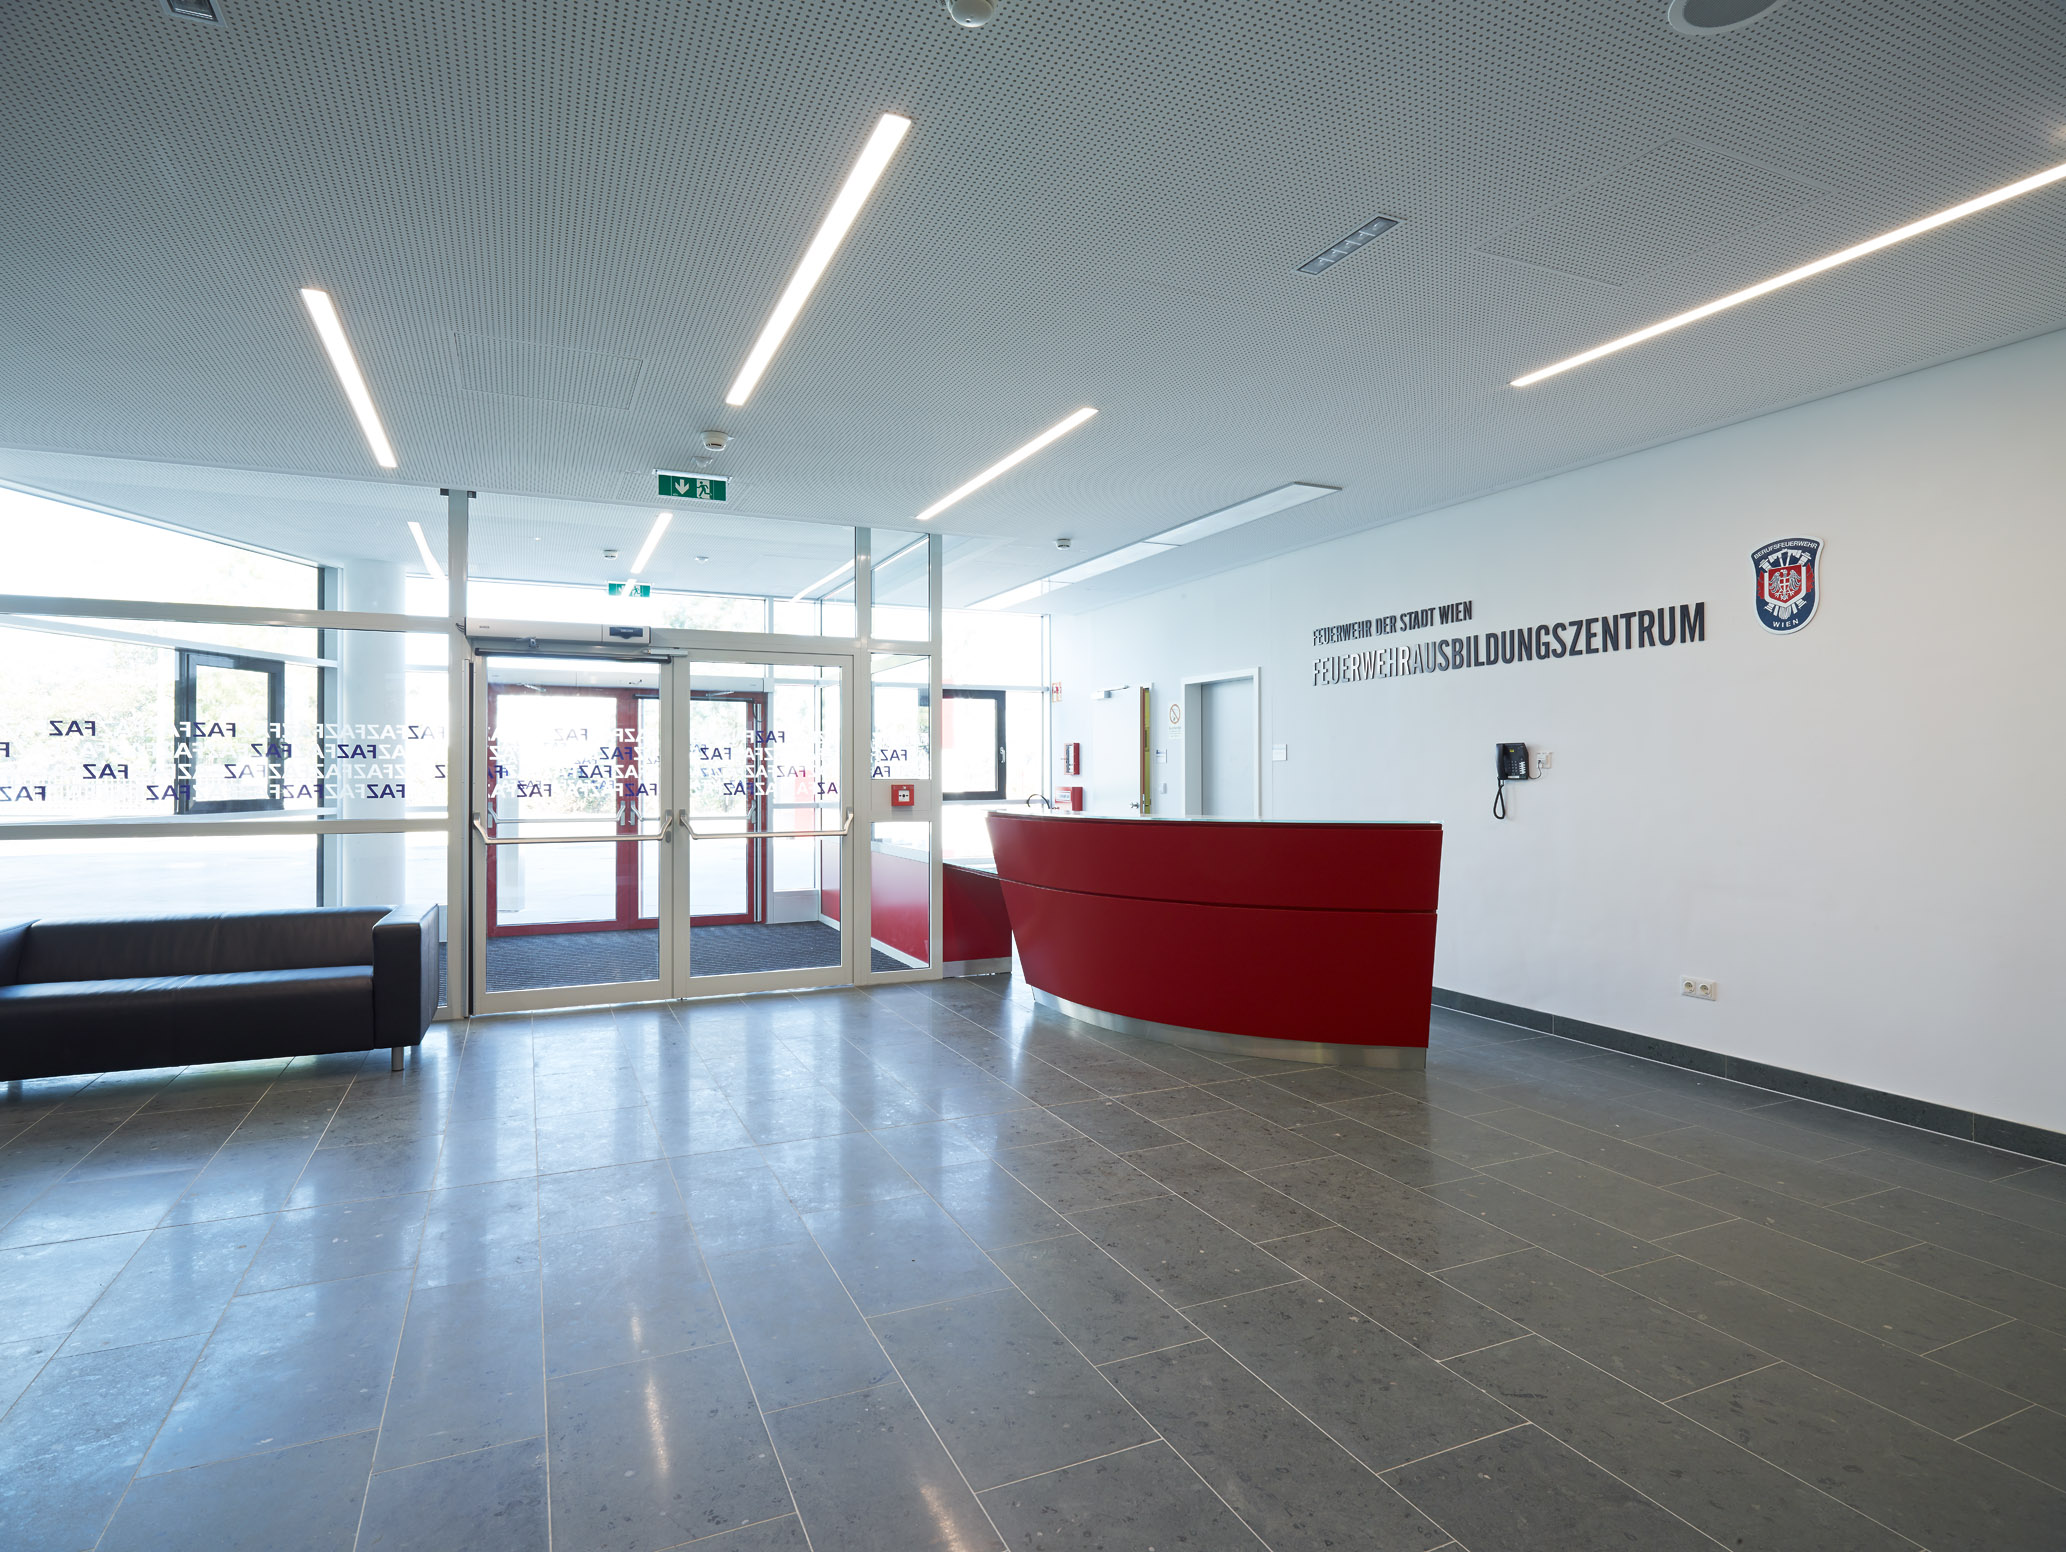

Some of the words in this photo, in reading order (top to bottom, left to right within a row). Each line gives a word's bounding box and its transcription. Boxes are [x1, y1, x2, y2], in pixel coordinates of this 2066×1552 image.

[1753, 541, 1818, 560] BERUFSFEUERWEHR
[1313, 619, 1372, 646] FEUERWEHR
[1375, 615, 1397, 637] DER
[1400, 607, 1435, 632] STADT
[1438, 600, 1472, 625] WIEN
[1772, 619, 1799, 628] WIEN
[1313, 601, 1706, 686] FEUERWEHRAUSBILDUNGSZENTRUM
